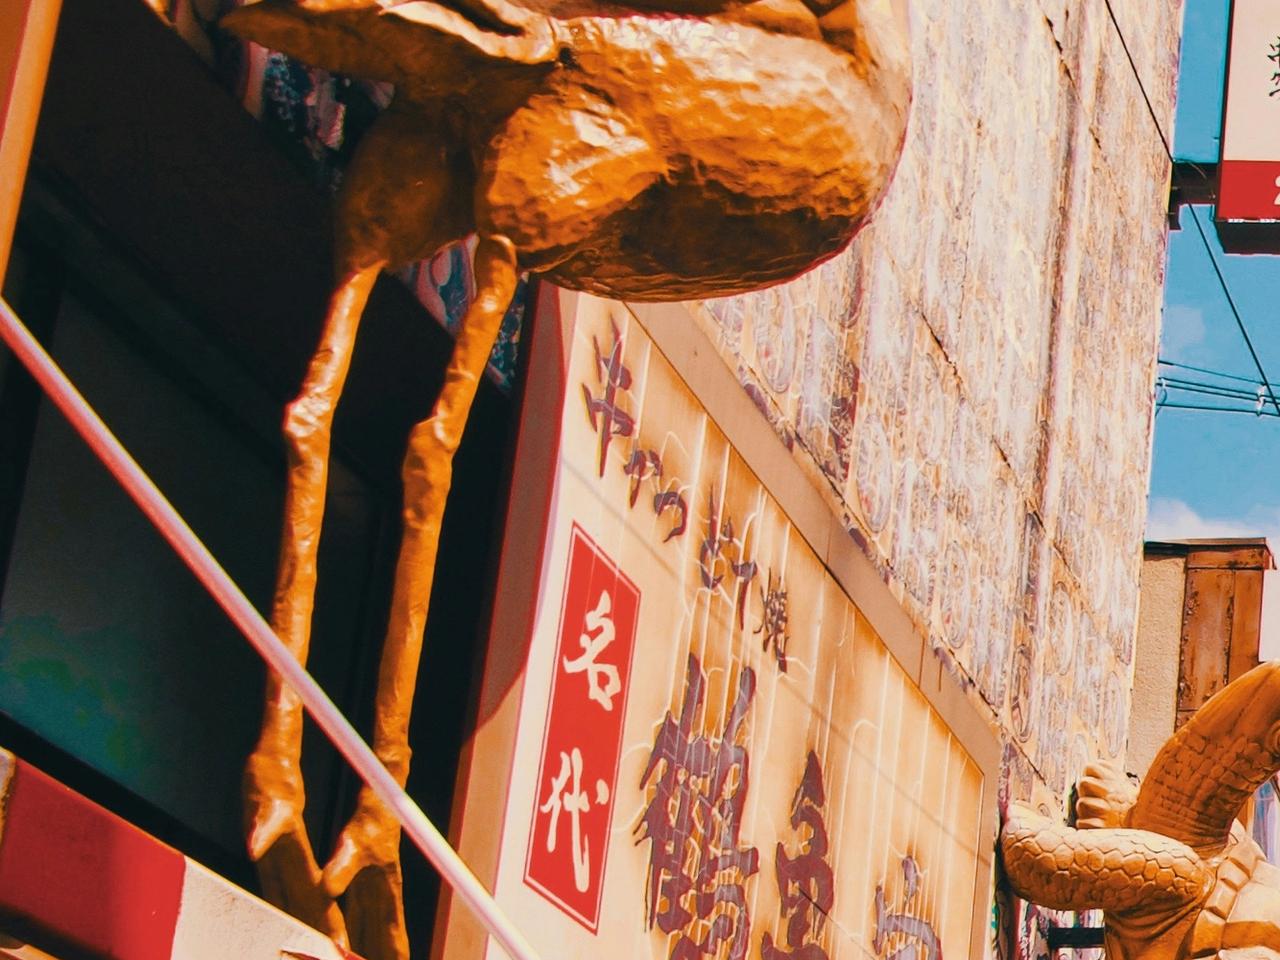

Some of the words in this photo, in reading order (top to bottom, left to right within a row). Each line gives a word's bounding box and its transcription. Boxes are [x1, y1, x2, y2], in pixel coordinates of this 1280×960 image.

[582, 316, 688, 542] 串かつ
[538, 594, 622, 893] 名代
